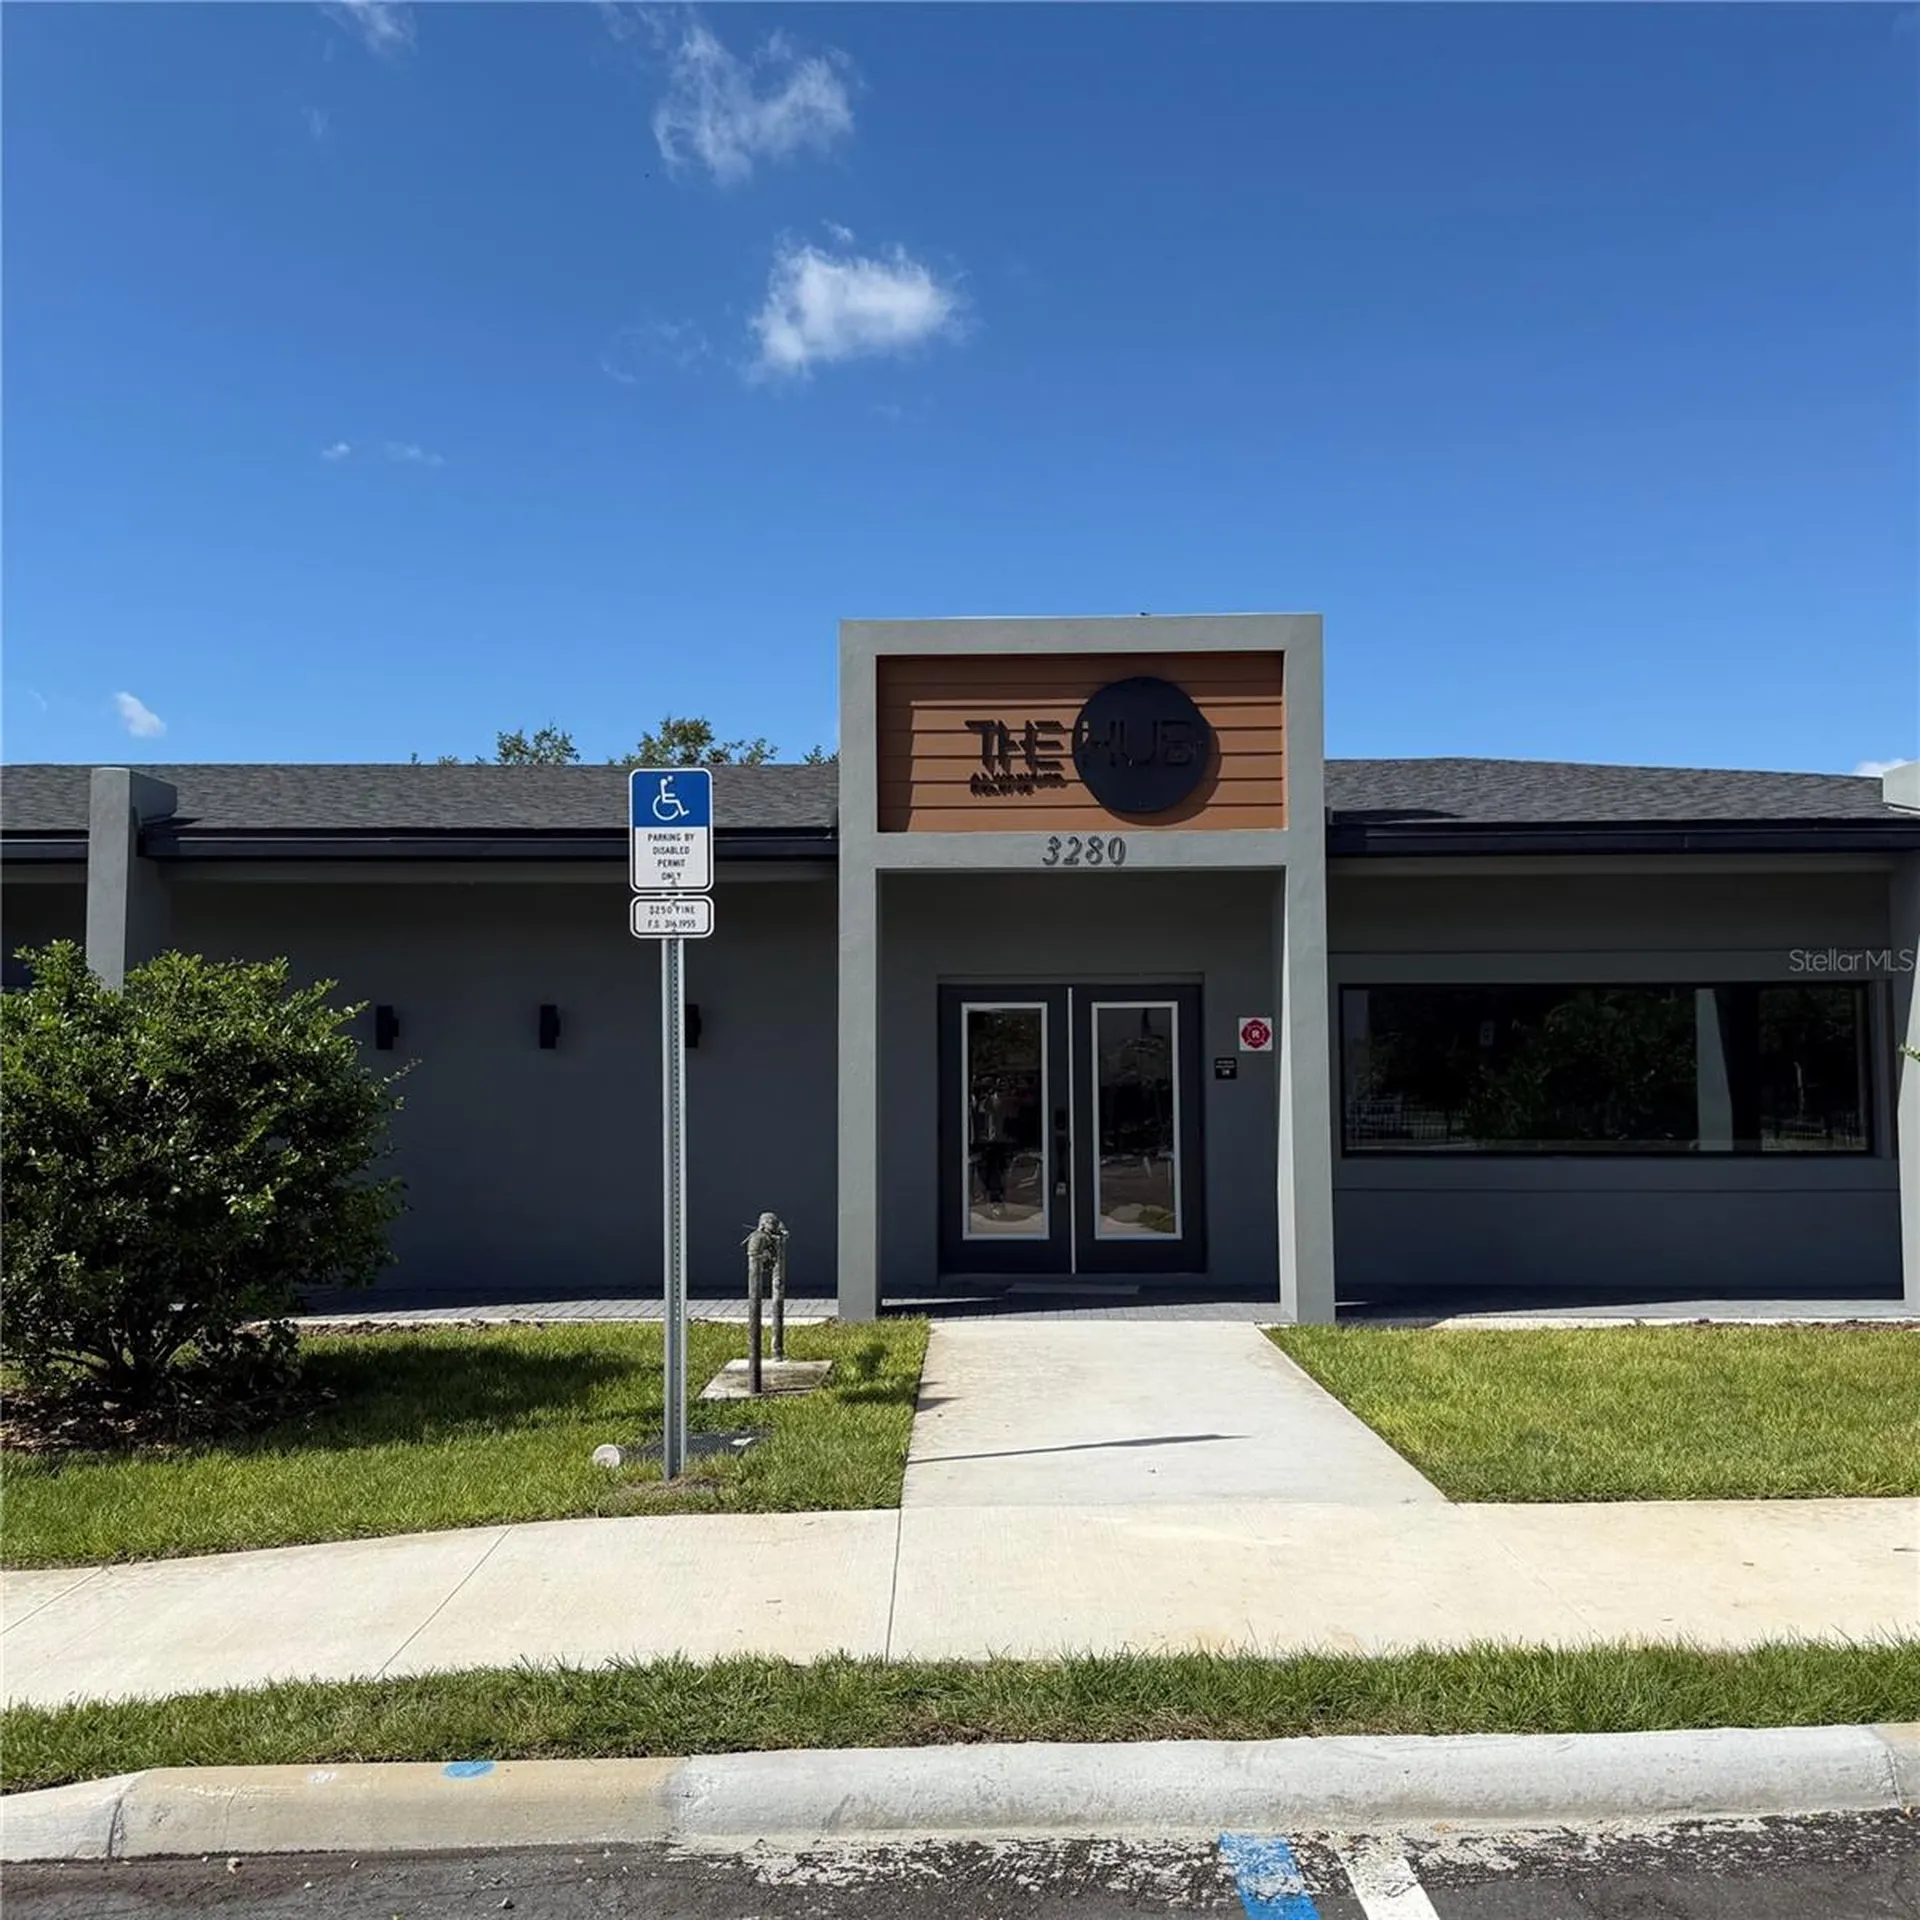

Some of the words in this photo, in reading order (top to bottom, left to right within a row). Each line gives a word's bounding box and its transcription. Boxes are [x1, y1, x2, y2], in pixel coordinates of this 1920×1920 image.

[965, 719, 1064, 773] THE
[1077, 719, 1197, 768] HUB
[647, 833, 682, 842] PARKING
[684, 833, 695, 842] BY
[652, 846, 691, 855] DISABLED
[1042, 835, 1127, 866] 3280
[657, 858, 686, 868] PERMIT
[661, 871, 682, 881] ONLY
[675, 905, 696, 914] FINE
